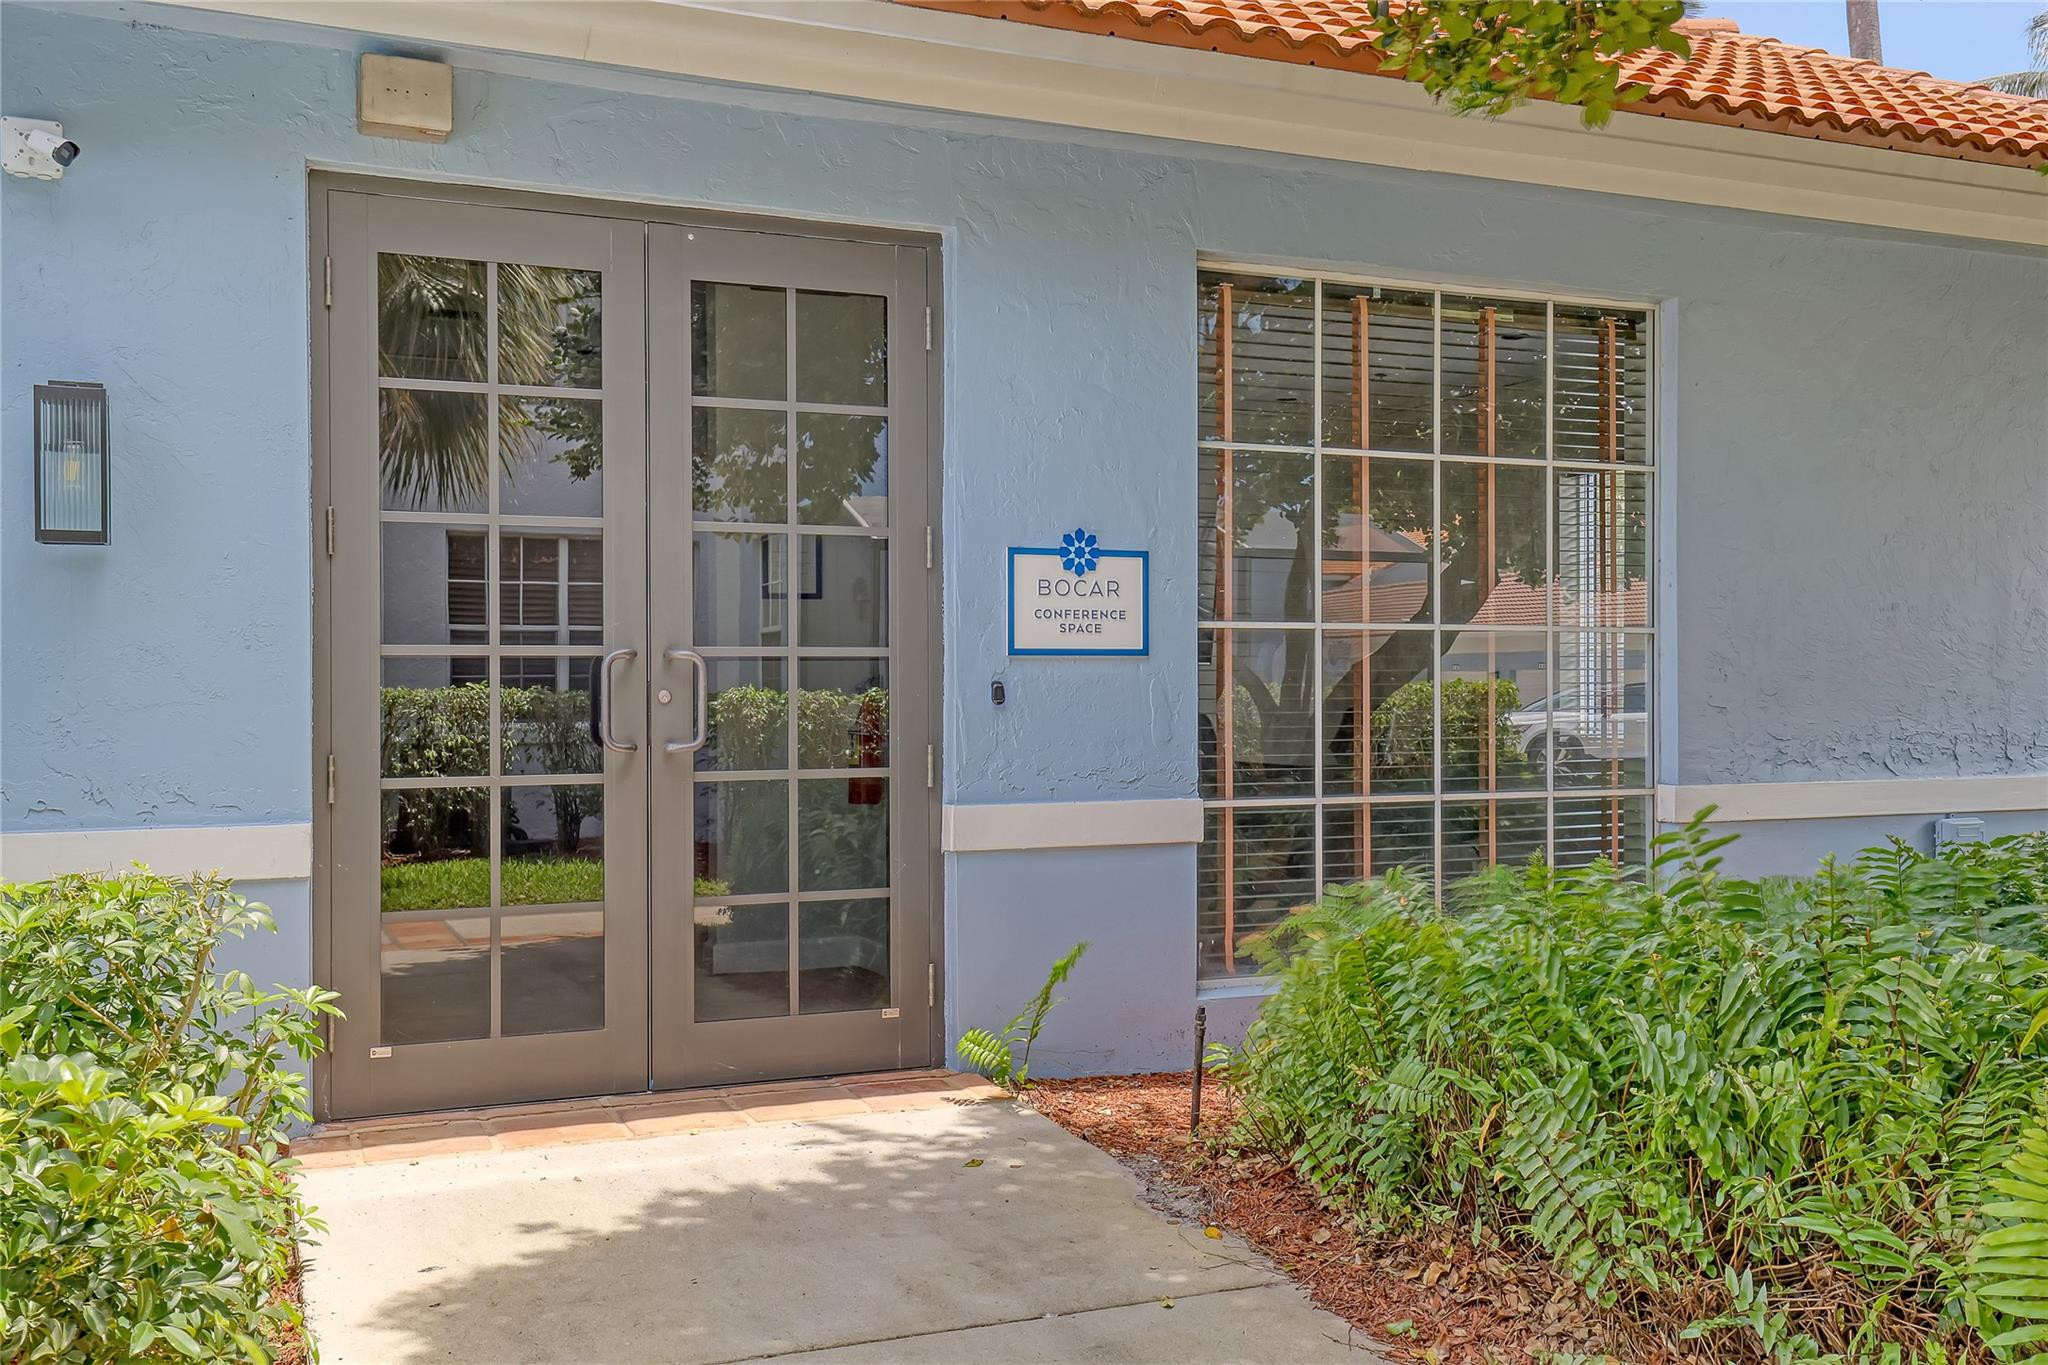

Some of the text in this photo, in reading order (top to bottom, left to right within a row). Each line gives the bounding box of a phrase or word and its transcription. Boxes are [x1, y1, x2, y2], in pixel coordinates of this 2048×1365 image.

[1038, 579, 1120, 597] BOCAR
[1034, 609, 1126, 620] CONFERENCE
[1059, 623, 1102, 633] SPACE
